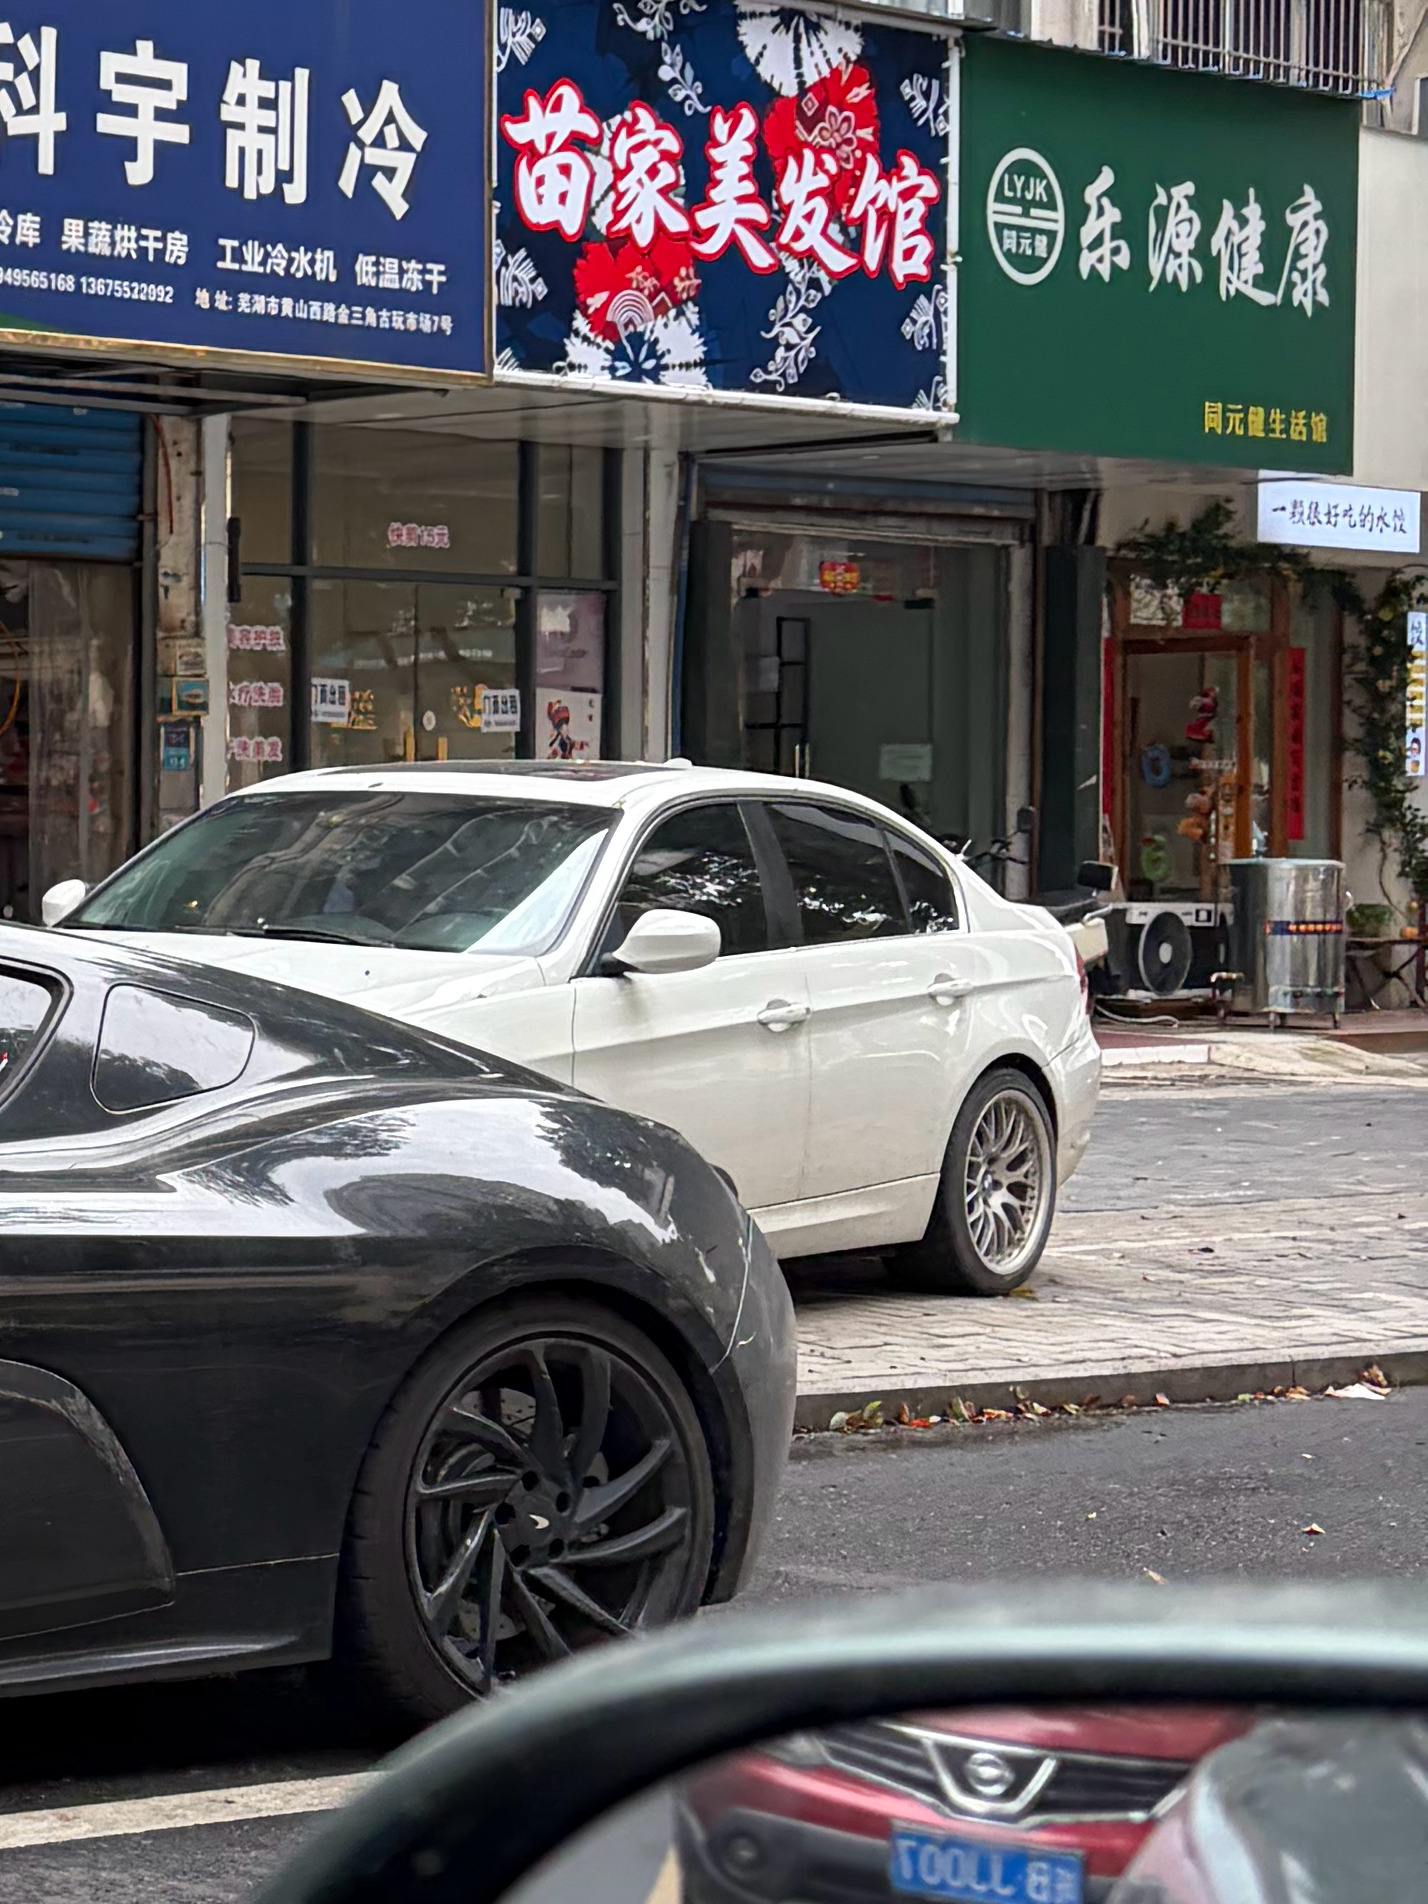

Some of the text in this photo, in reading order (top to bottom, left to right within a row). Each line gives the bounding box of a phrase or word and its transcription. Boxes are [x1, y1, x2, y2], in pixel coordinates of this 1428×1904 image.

[501, 76, 941, 289] 苗家美发馆
[1003, 173, 1048, 203] LYJK
[61, 217, 190, 266] 果蔬烘干房
[216, 237, 338, 283] 工业冷水机
[354, 253, 448, 295] 低温冻干
[1079, 165, 1330, 318] 乐源健康
[1204, 400, 1329, 443] 同元健生活馆
